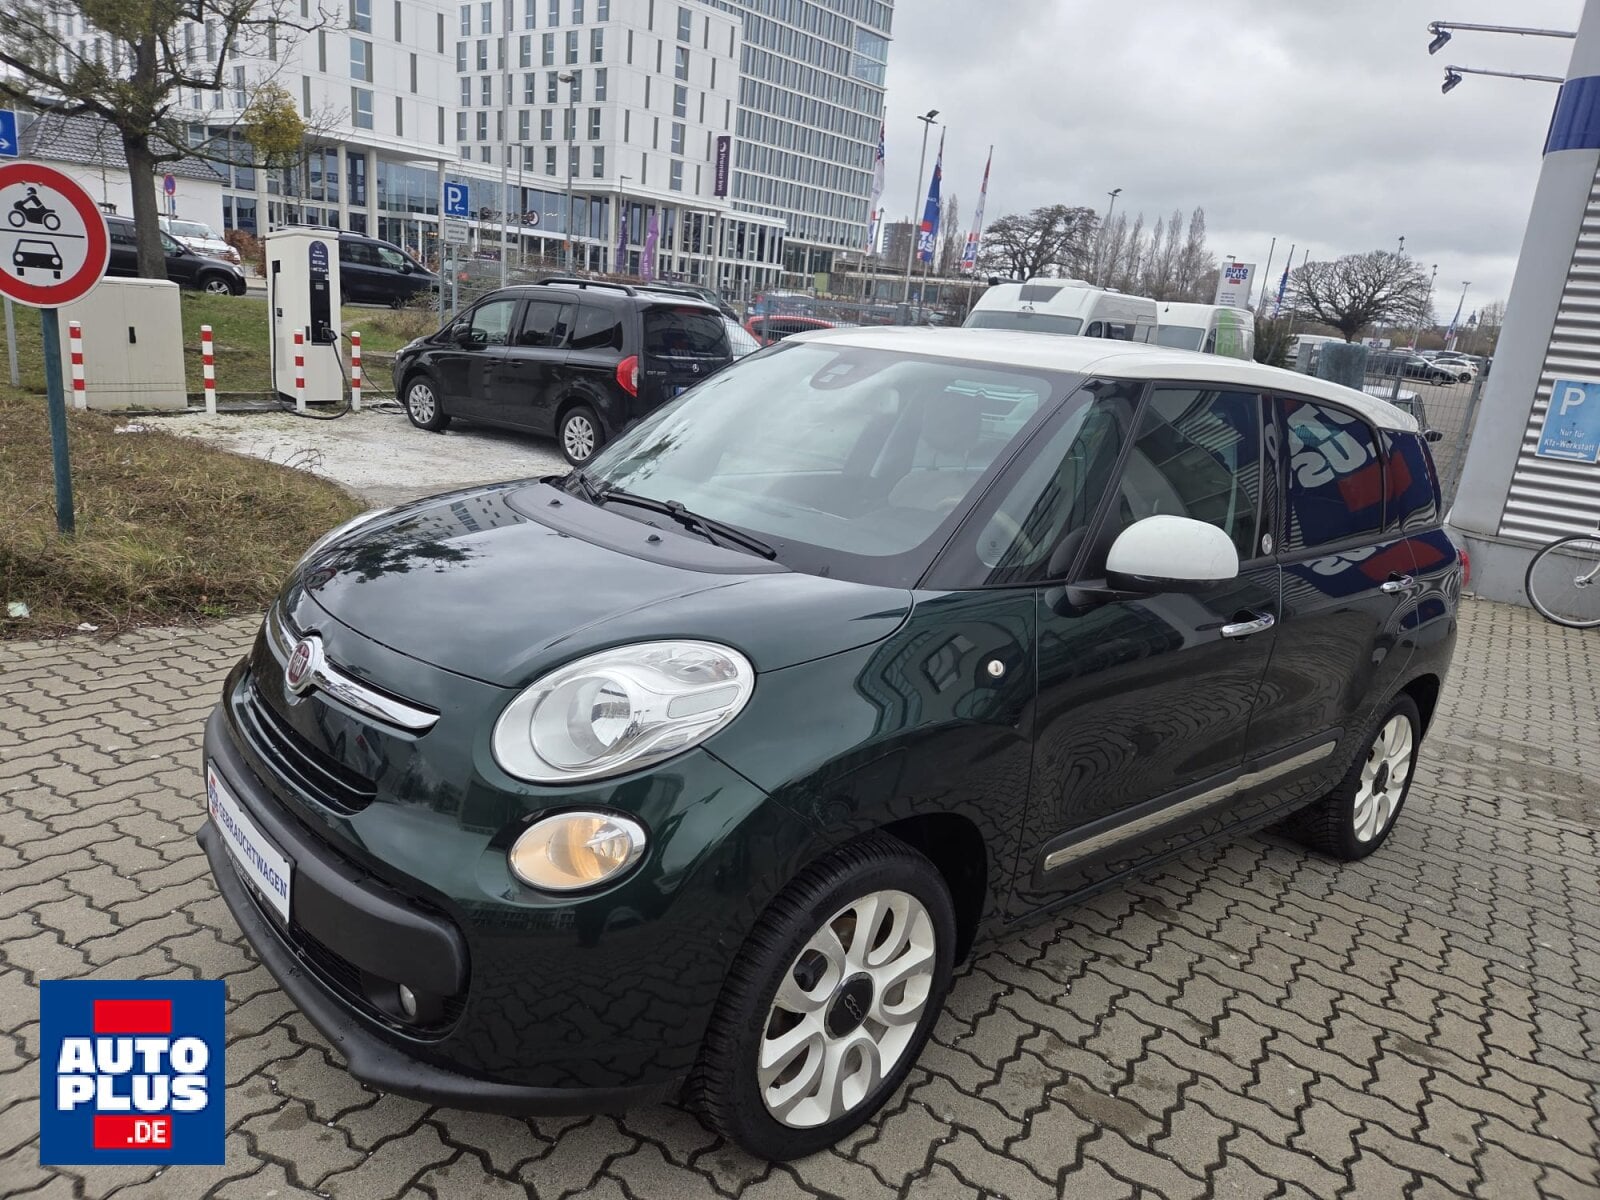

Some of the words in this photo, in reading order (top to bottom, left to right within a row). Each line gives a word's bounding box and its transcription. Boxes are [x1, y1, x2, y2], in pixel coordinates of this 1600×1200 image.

[447, 186, 462, 211] P
[1225, 272, 1248, 280] PLUS
[1560, 387, 1586, 416] P
[1544, 438, 1595, 452] Kfz-Werkstatt
[1560, 428, 1573, 438] Nur
[1574, 429, 1585, 439] für
[291, 651, 306, 678] FIAT
[218, 801, 288, 900] GEBRAUCHTWAGEN
